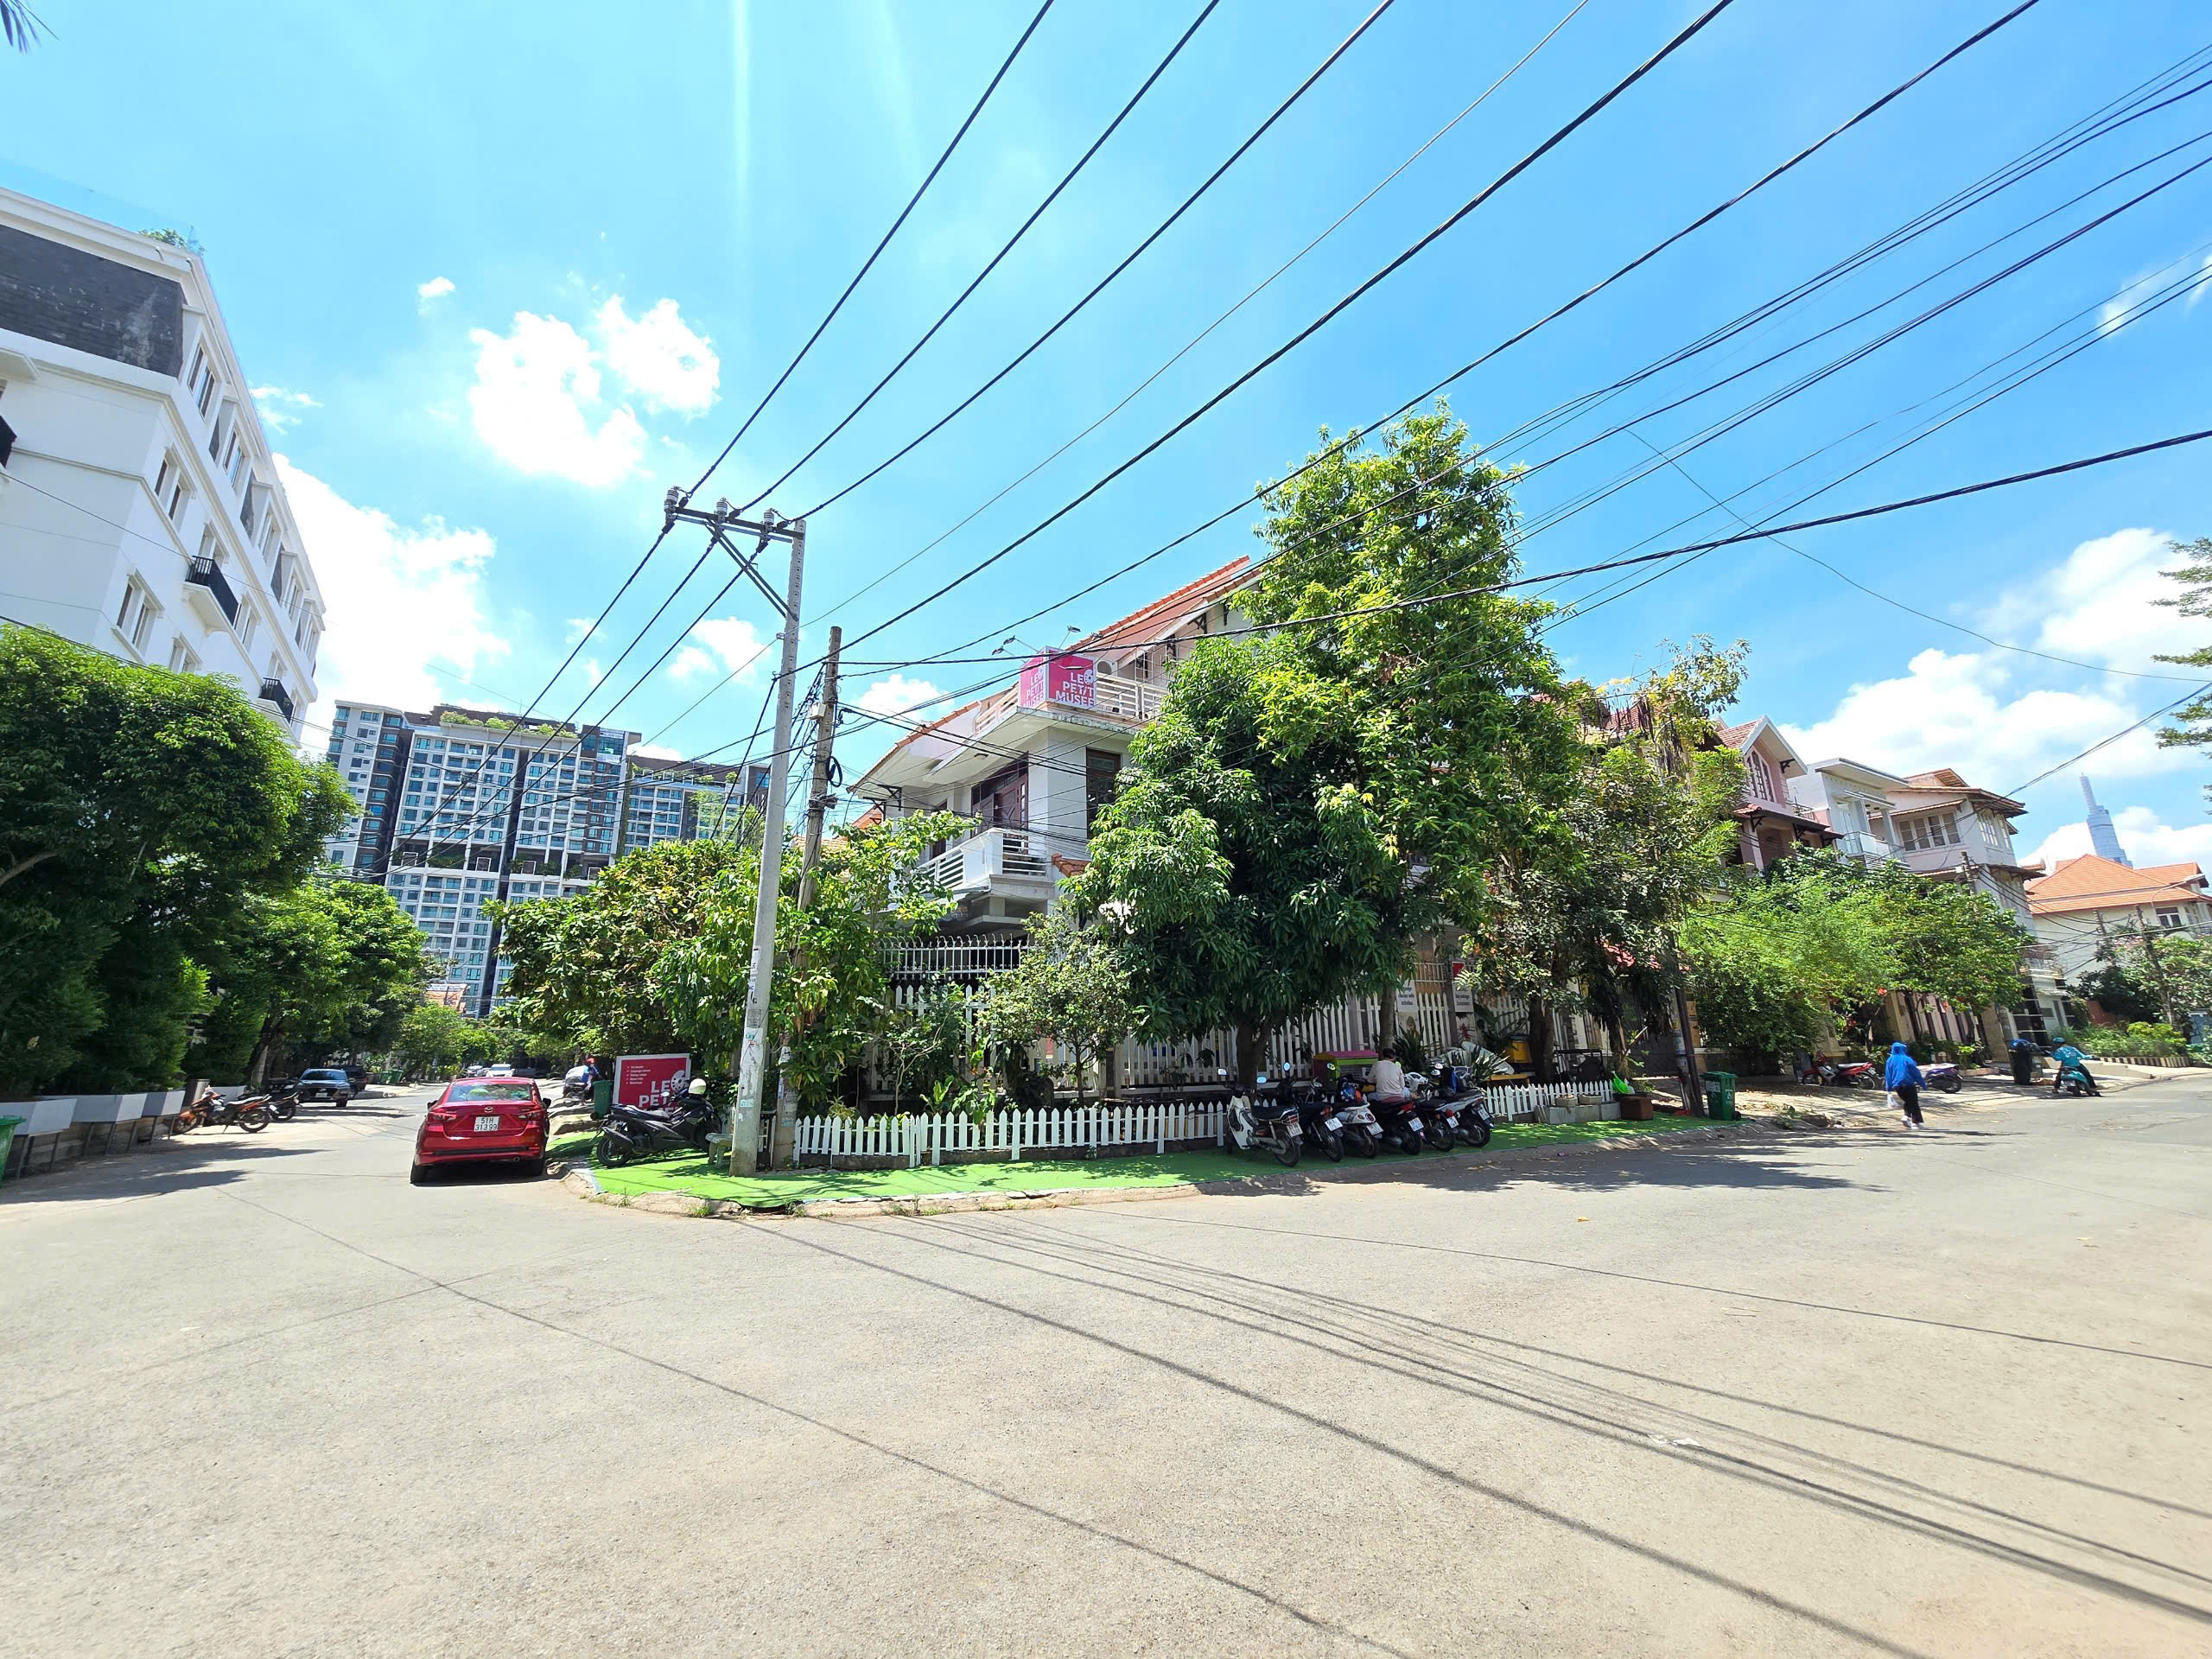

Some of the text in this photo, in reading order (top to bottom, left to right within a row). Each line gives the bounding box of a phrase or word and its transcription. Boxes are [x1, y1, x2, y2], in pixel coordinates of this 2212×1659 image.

[1030, 675, 1039, 685] LE
[1070, 672, 1085, 683] LE
[1026, 681, 1044, 699] PETIT
[1063, 681, 1094, 697] PETIT
[1055, 690, 1095, 706] MUSEE
[651, 1080, 671, 1093] LE
